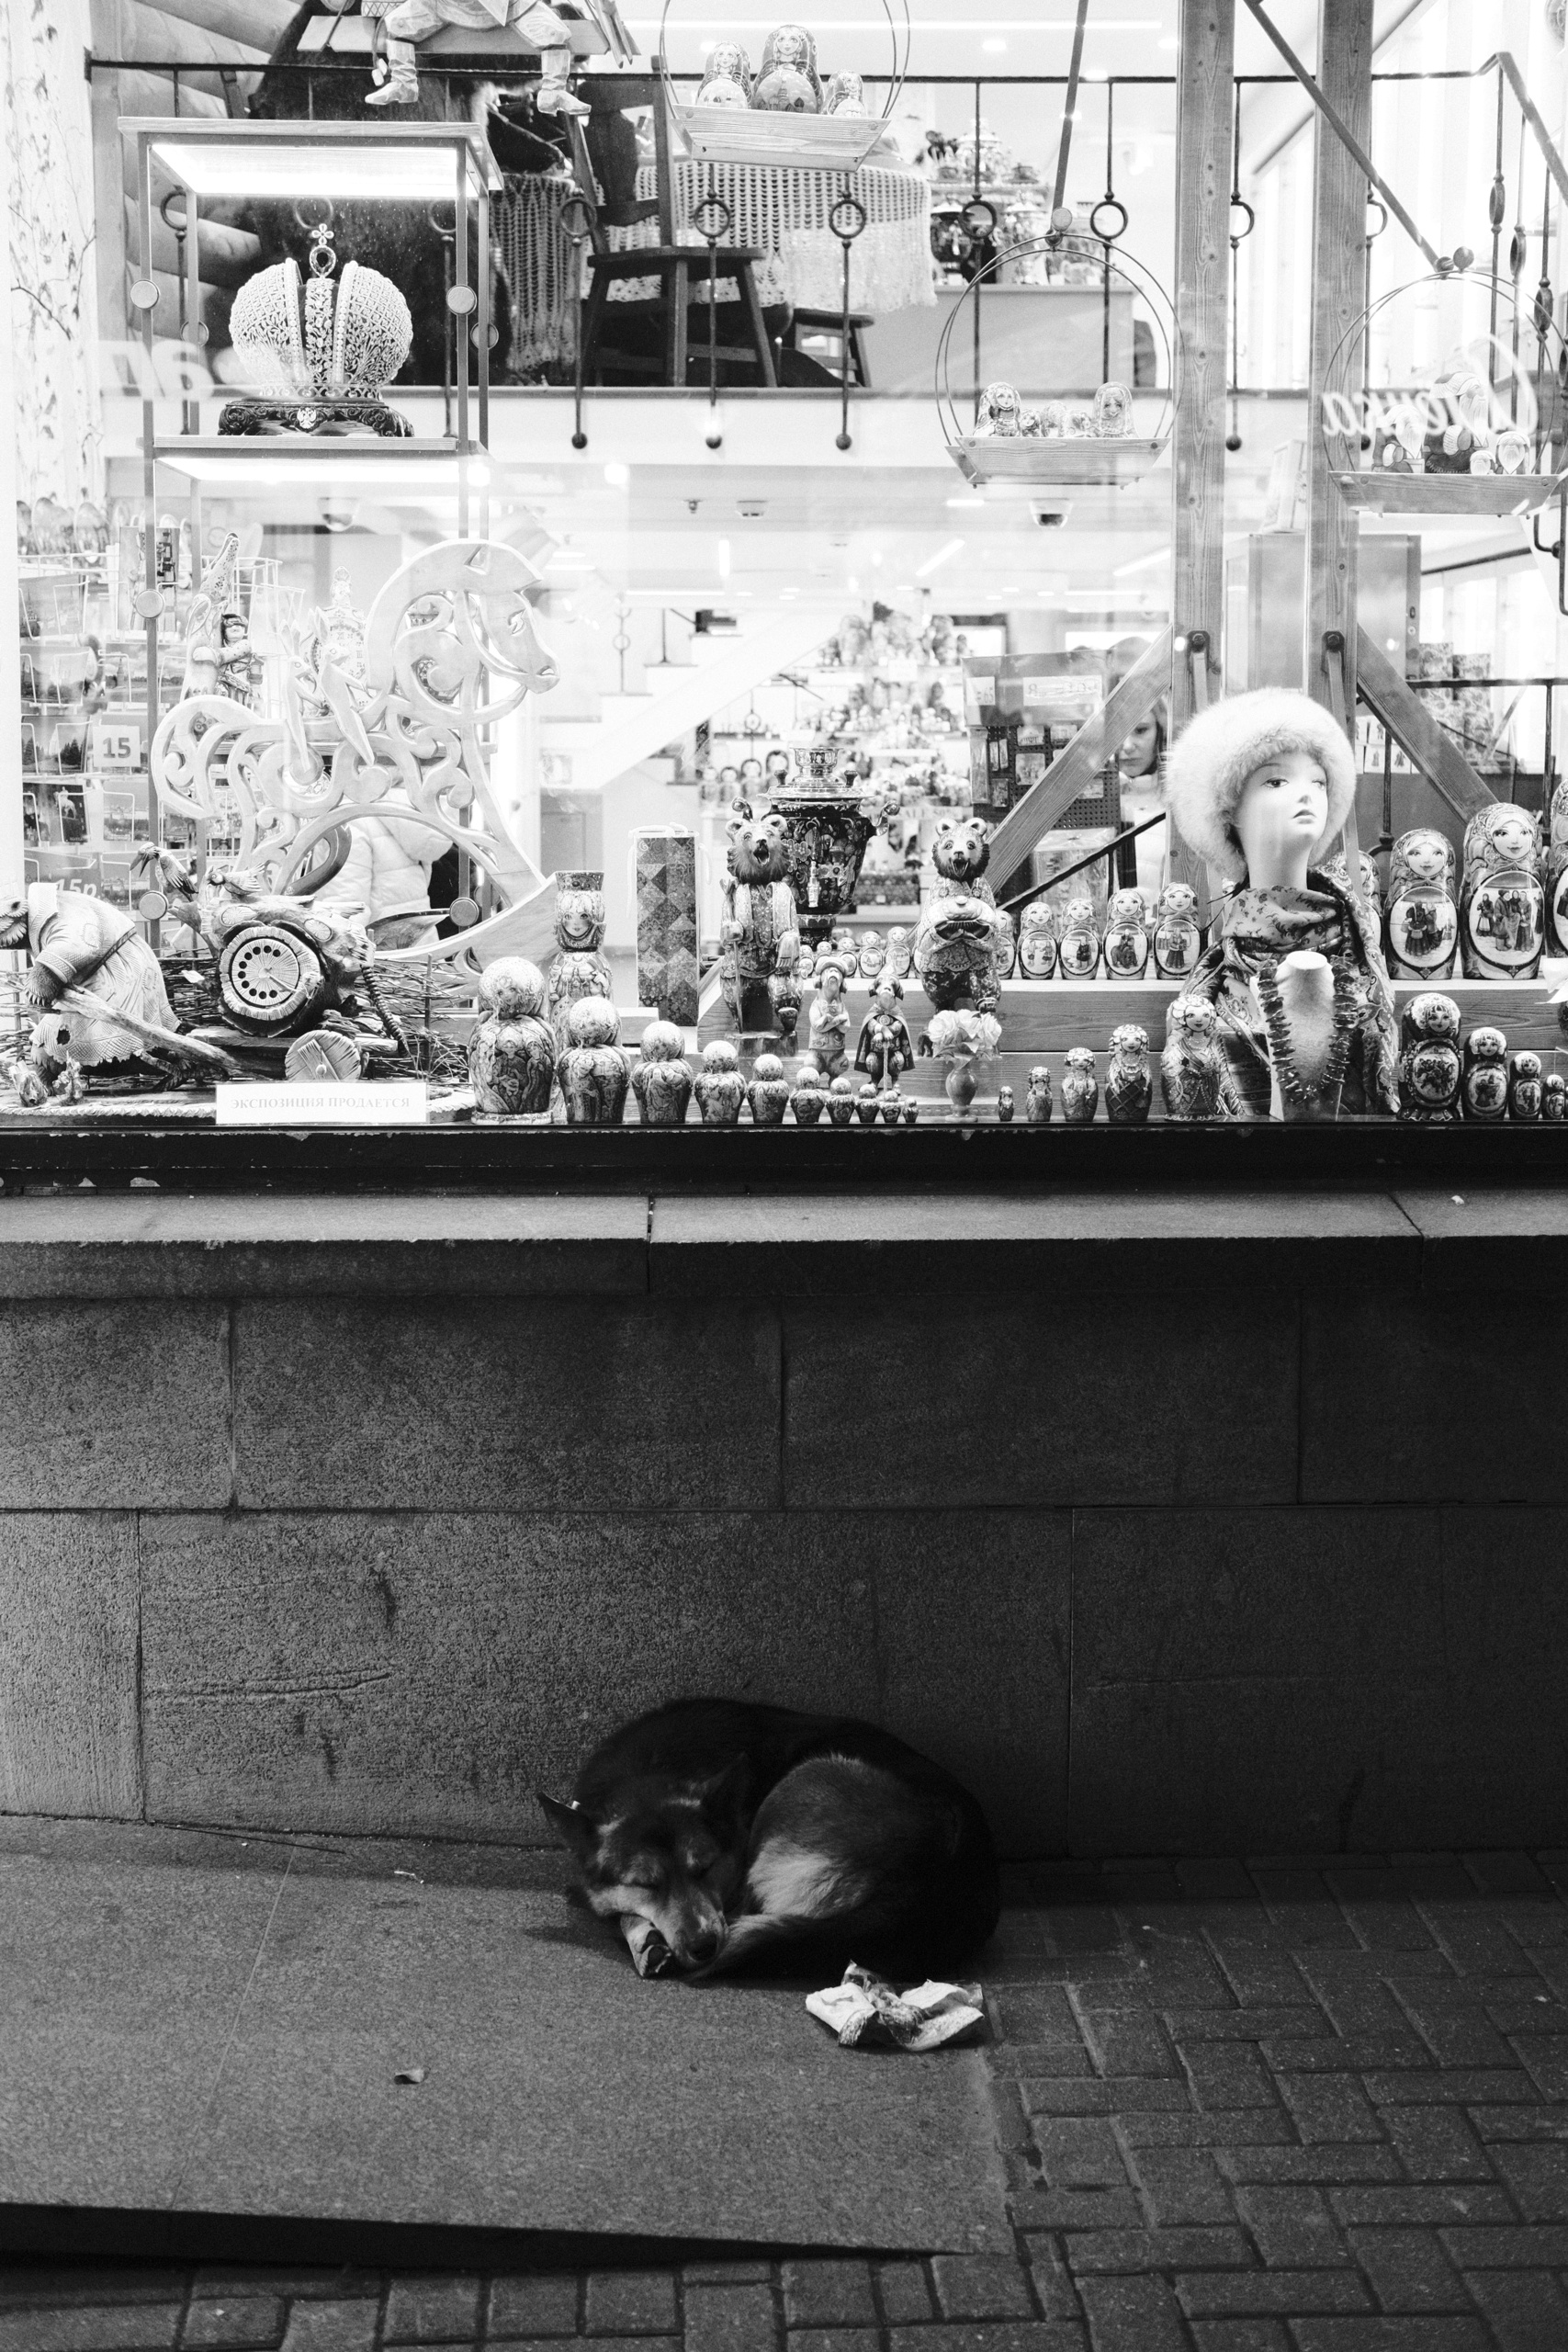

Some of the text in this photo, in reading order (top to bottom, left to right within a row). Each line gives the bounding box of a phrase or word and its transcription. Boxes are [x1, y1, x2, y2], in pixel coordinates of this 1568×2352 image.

[103, 737, 131, 759] 15
[231, 1097, 410, 1110] ЭКСПОЗИЦИЯ ПРОДАЕТСЯ
